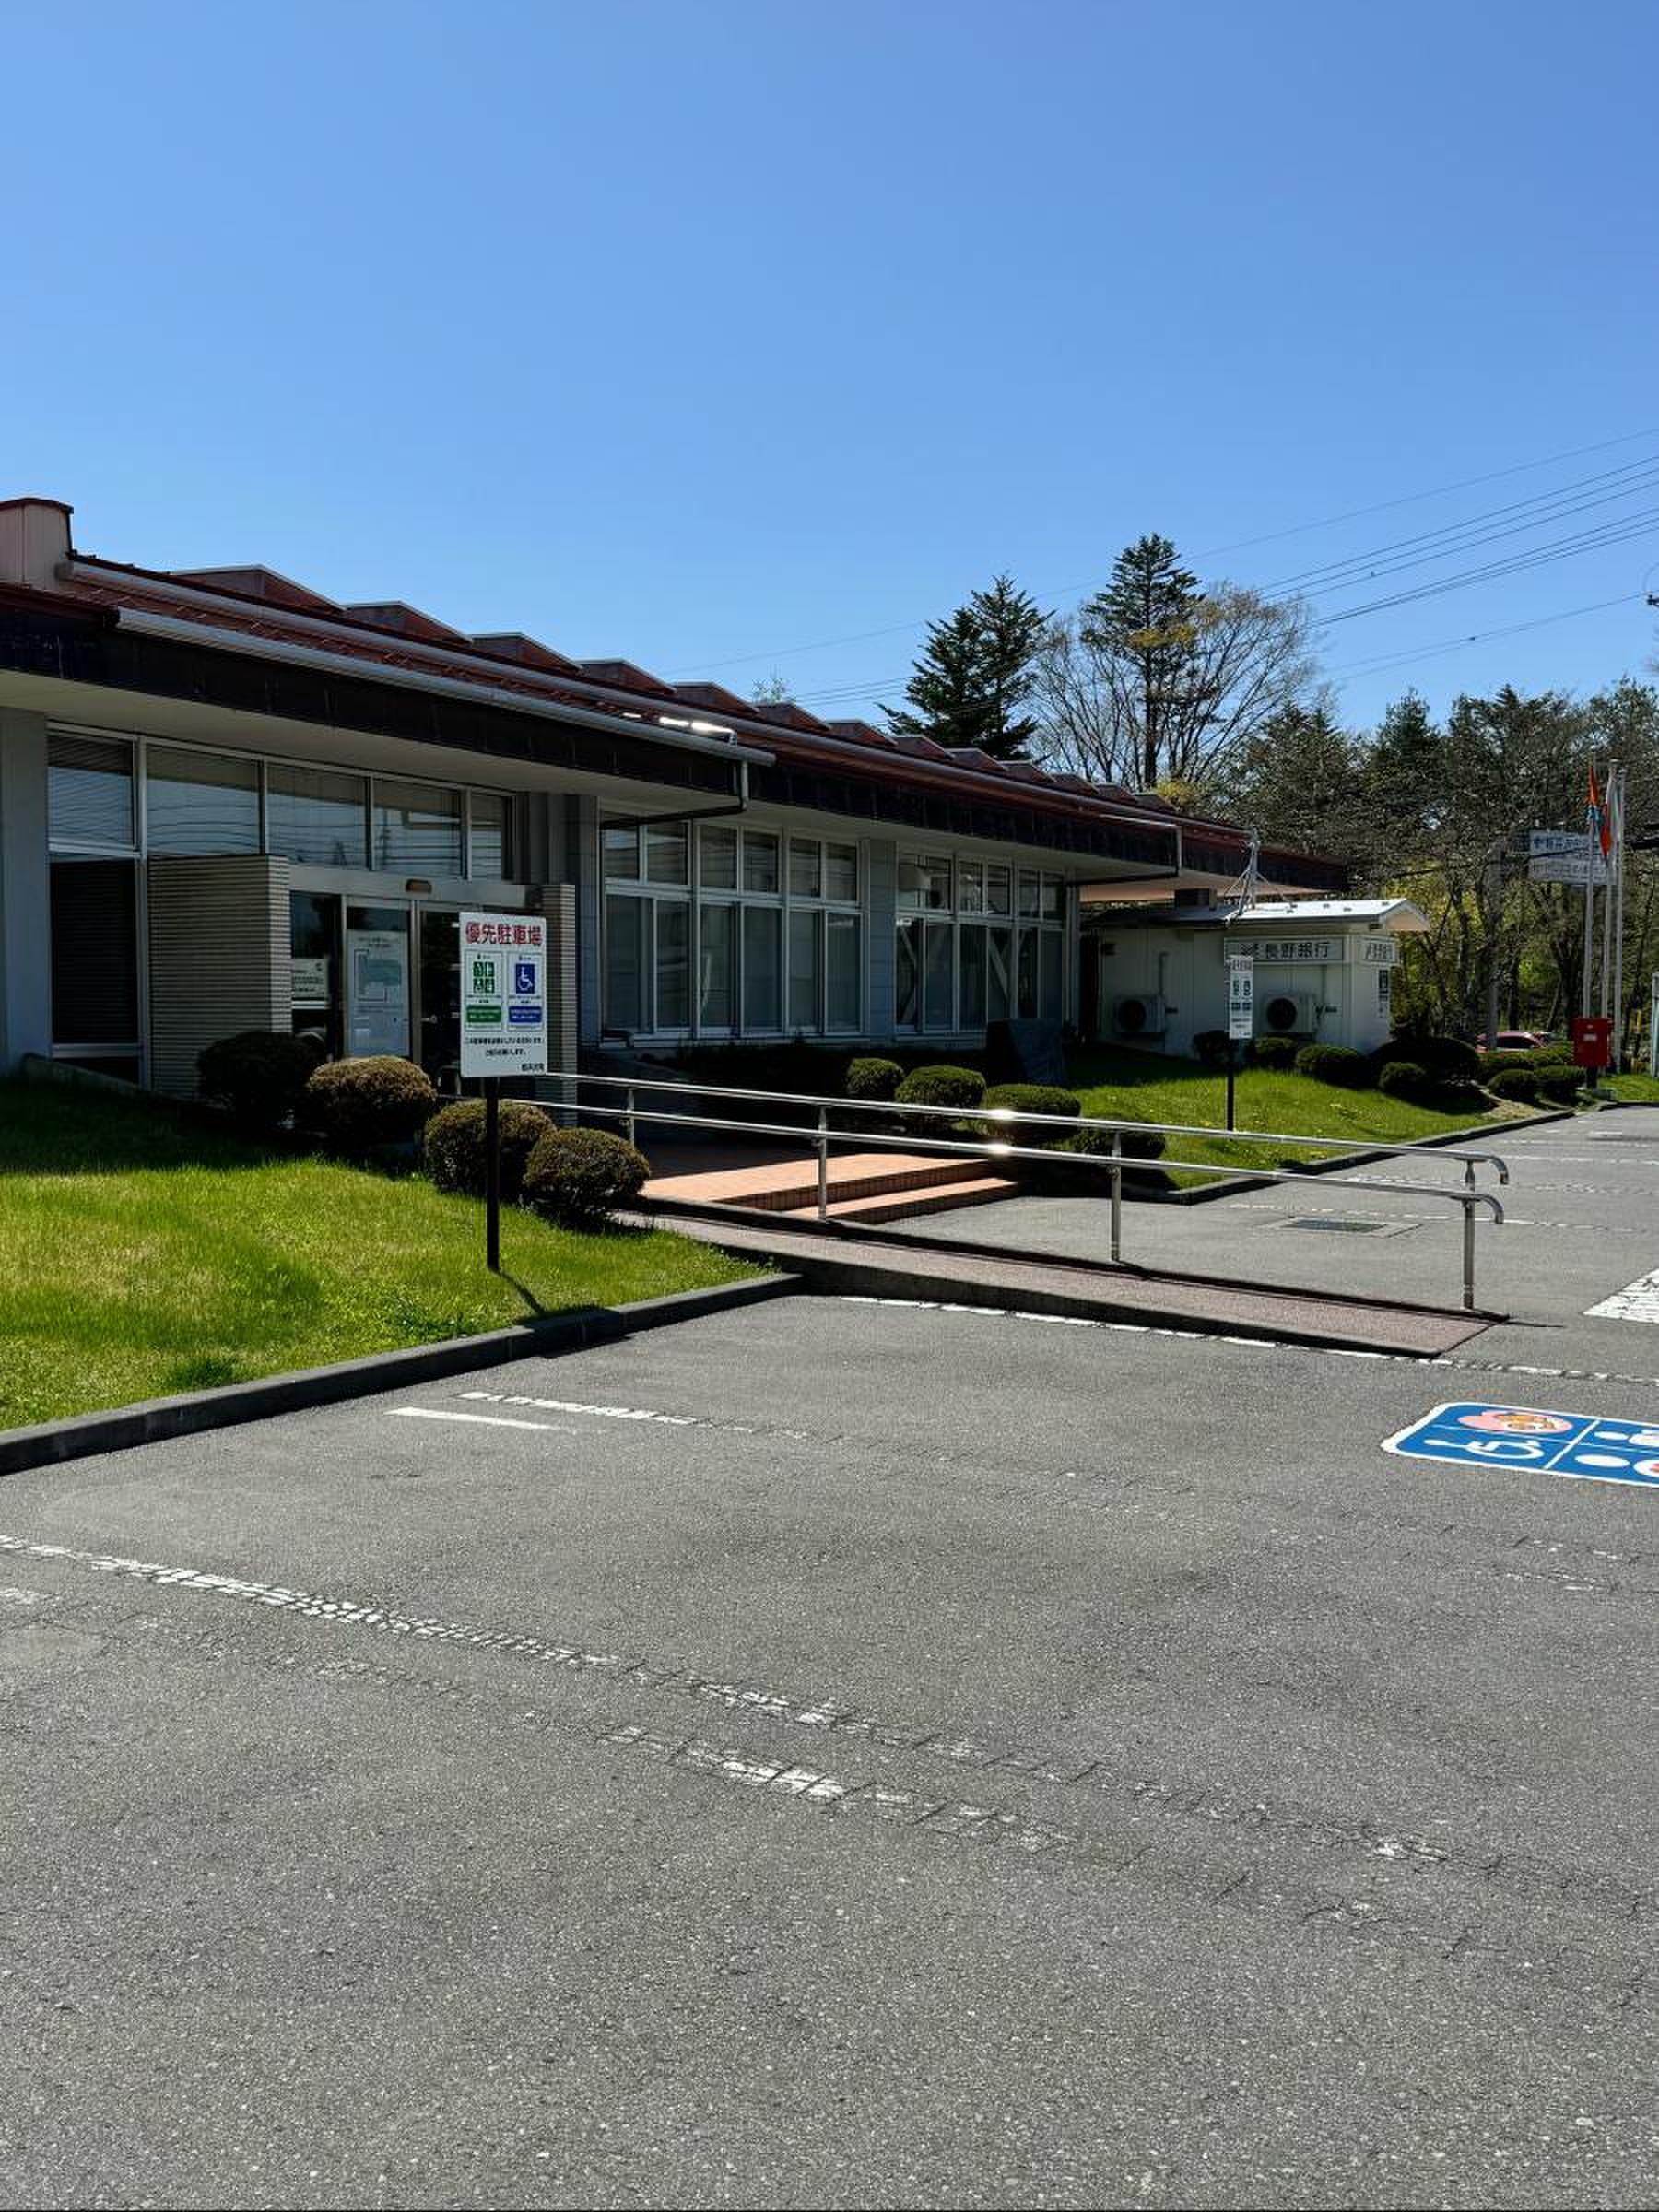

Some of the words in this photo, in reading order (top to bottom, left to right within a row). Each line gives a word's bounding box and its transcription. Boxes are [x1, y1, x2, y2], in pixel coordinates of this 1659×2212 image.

[465, 922, 543, 946] 優先駐車場
[1266, 942, 1330, 959] 長野銀行
